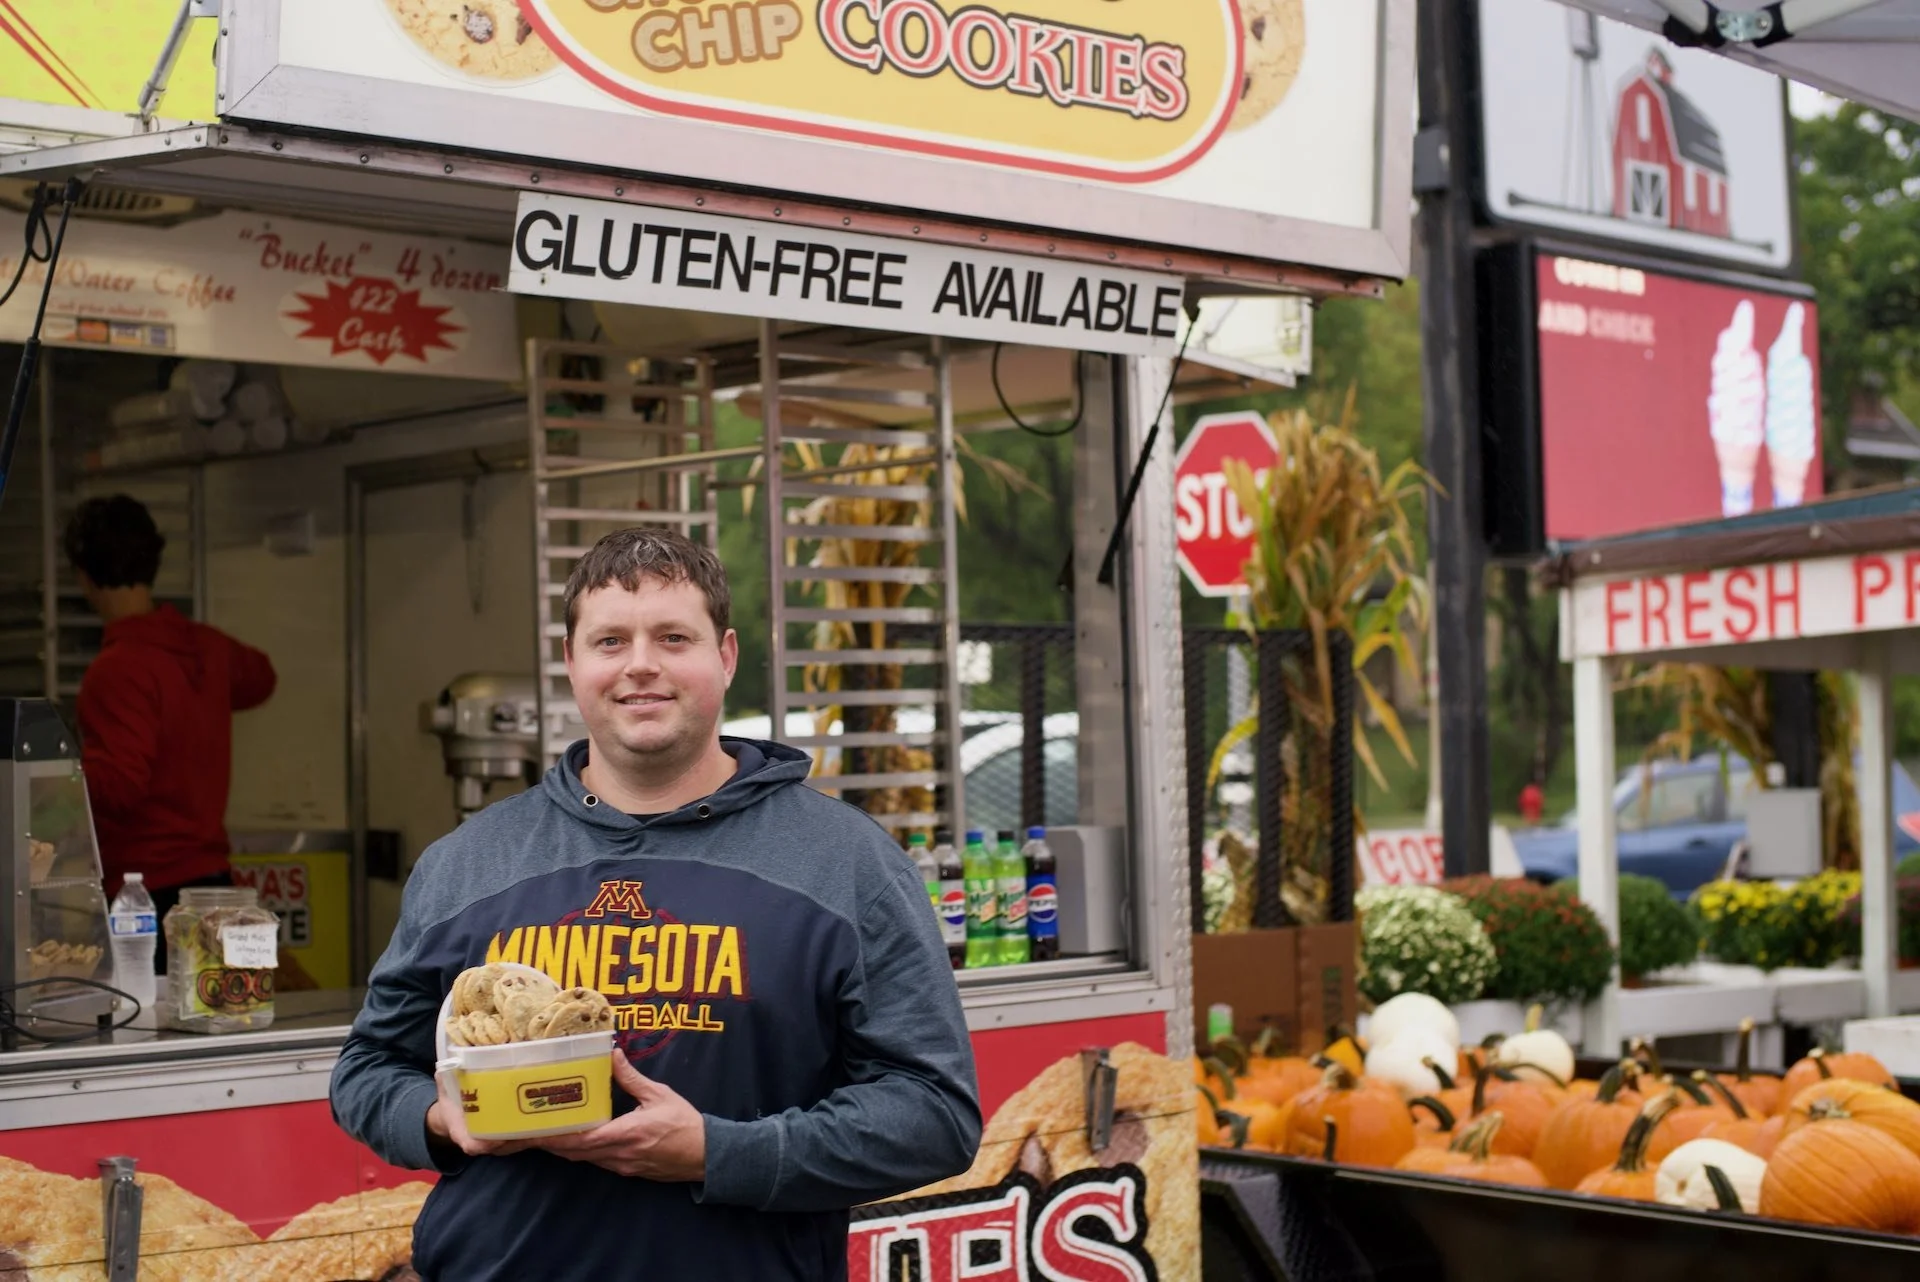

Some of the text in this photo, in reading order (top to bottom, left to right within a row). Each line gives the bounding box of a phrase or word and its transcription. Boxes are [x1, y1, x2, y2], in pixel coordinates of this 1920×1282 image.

[631, 0, 803, 73] CHIP
[815, 0, 1189, 121] COOKIES
[153, 266, 237, 311] Coffee
[397, 246, 421, 284] 4
[515, 209, 1181, 337] GLUTEN-FREE AVAILABLE
[338, 317, 404, 350] Cash
[1604, 560, 1799, 655] FRESH
[585, 880, 651, 918] M
[485, 923, 746, 998] MINNESOTA
[611, 1001, 724, 1032] TBALL
